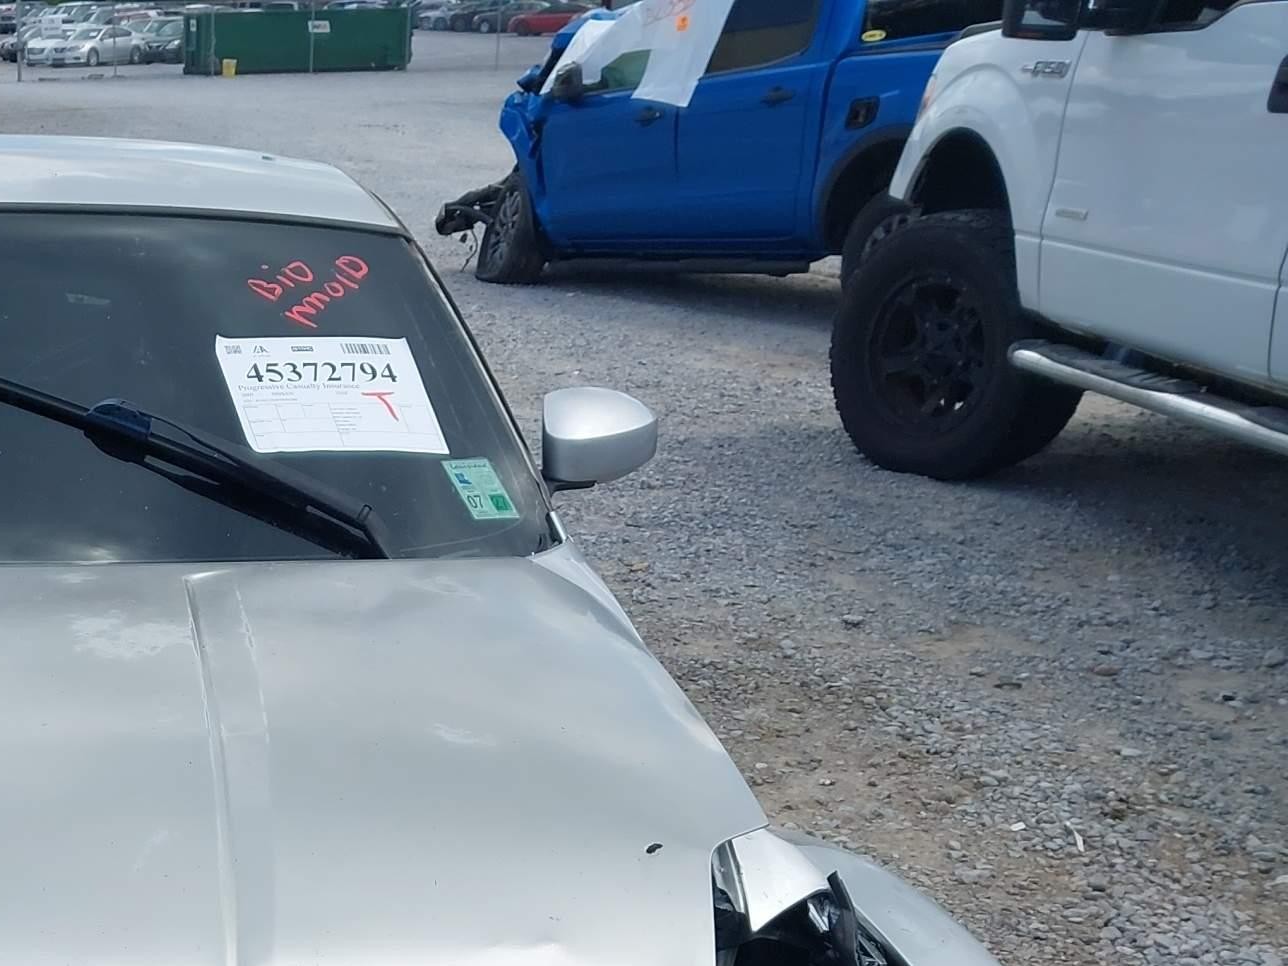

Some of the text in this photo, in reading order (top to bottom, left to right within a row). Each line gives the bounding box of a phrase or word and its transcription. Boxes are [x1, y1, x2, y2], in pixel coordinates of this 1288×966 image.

[246, 362, 398, 383] 45372794
[238, 384, 284, 392] Progressive
[286, 383, 321, 391] Casualty
[360, 391, 399, 422] T
[467, 495, 484, 509] 07
